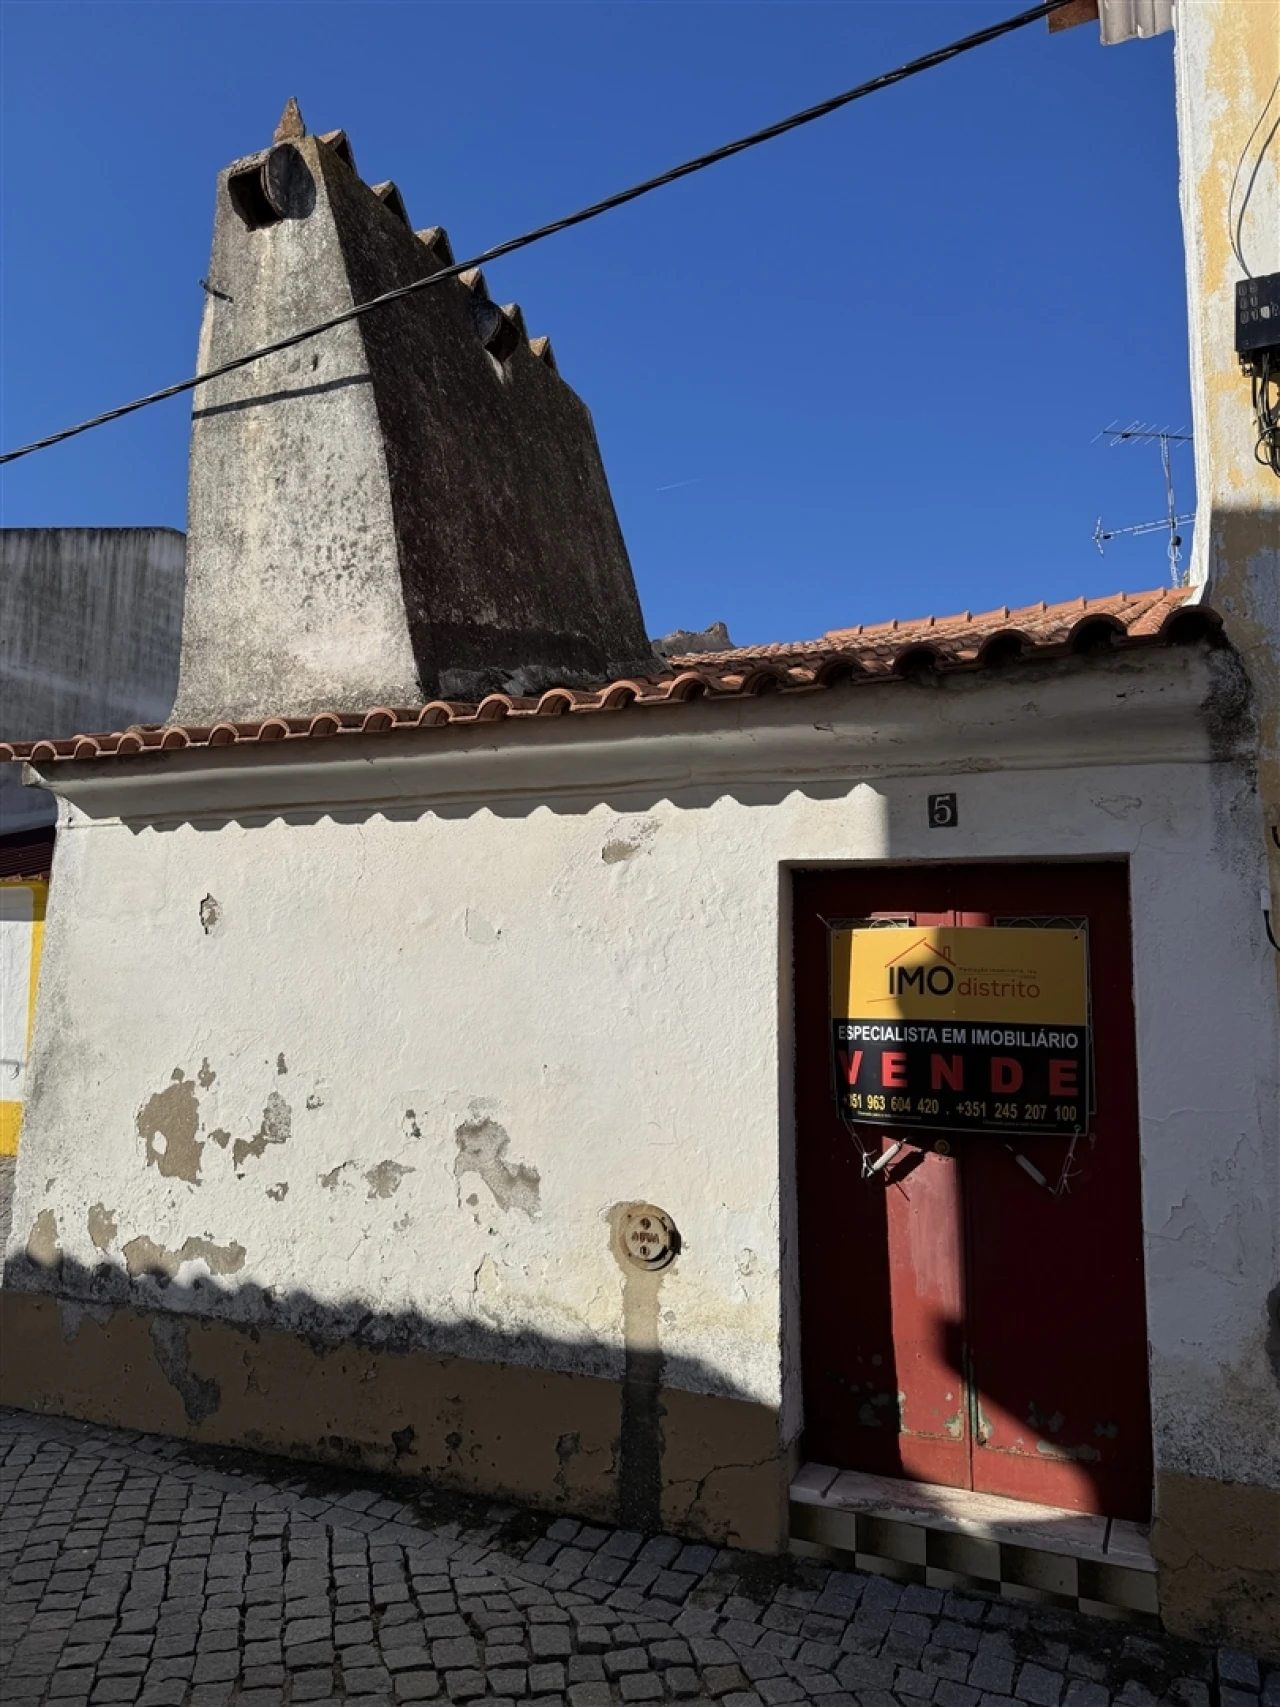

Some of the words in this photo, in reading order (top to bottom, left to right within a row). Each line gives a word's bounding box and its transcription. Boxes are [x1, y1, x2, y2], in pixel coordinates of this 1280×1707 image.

[933, 796, 952, 824] 5
[888, 965, 955, 996] IMO
[957, 977, 1041, 999] distrito
[838, 1025, 938, 1044] ESPECIALISTA
[941, 1028, 967, 1045] EM
[971, 1027, 1079, 1050] IMOBILIÁRIO
[866, 1094, 886, 1111] 963
[890, 1096, 912, 1113] 604
[916, 1098, 940, 1115] 420
[955, 1100, 987, 1117] +351
[993, 1102, 1019, 1119] 245
[1023, 1104, 1048, 1121] 207
[1054, 1105, 1078, 1122] 100
